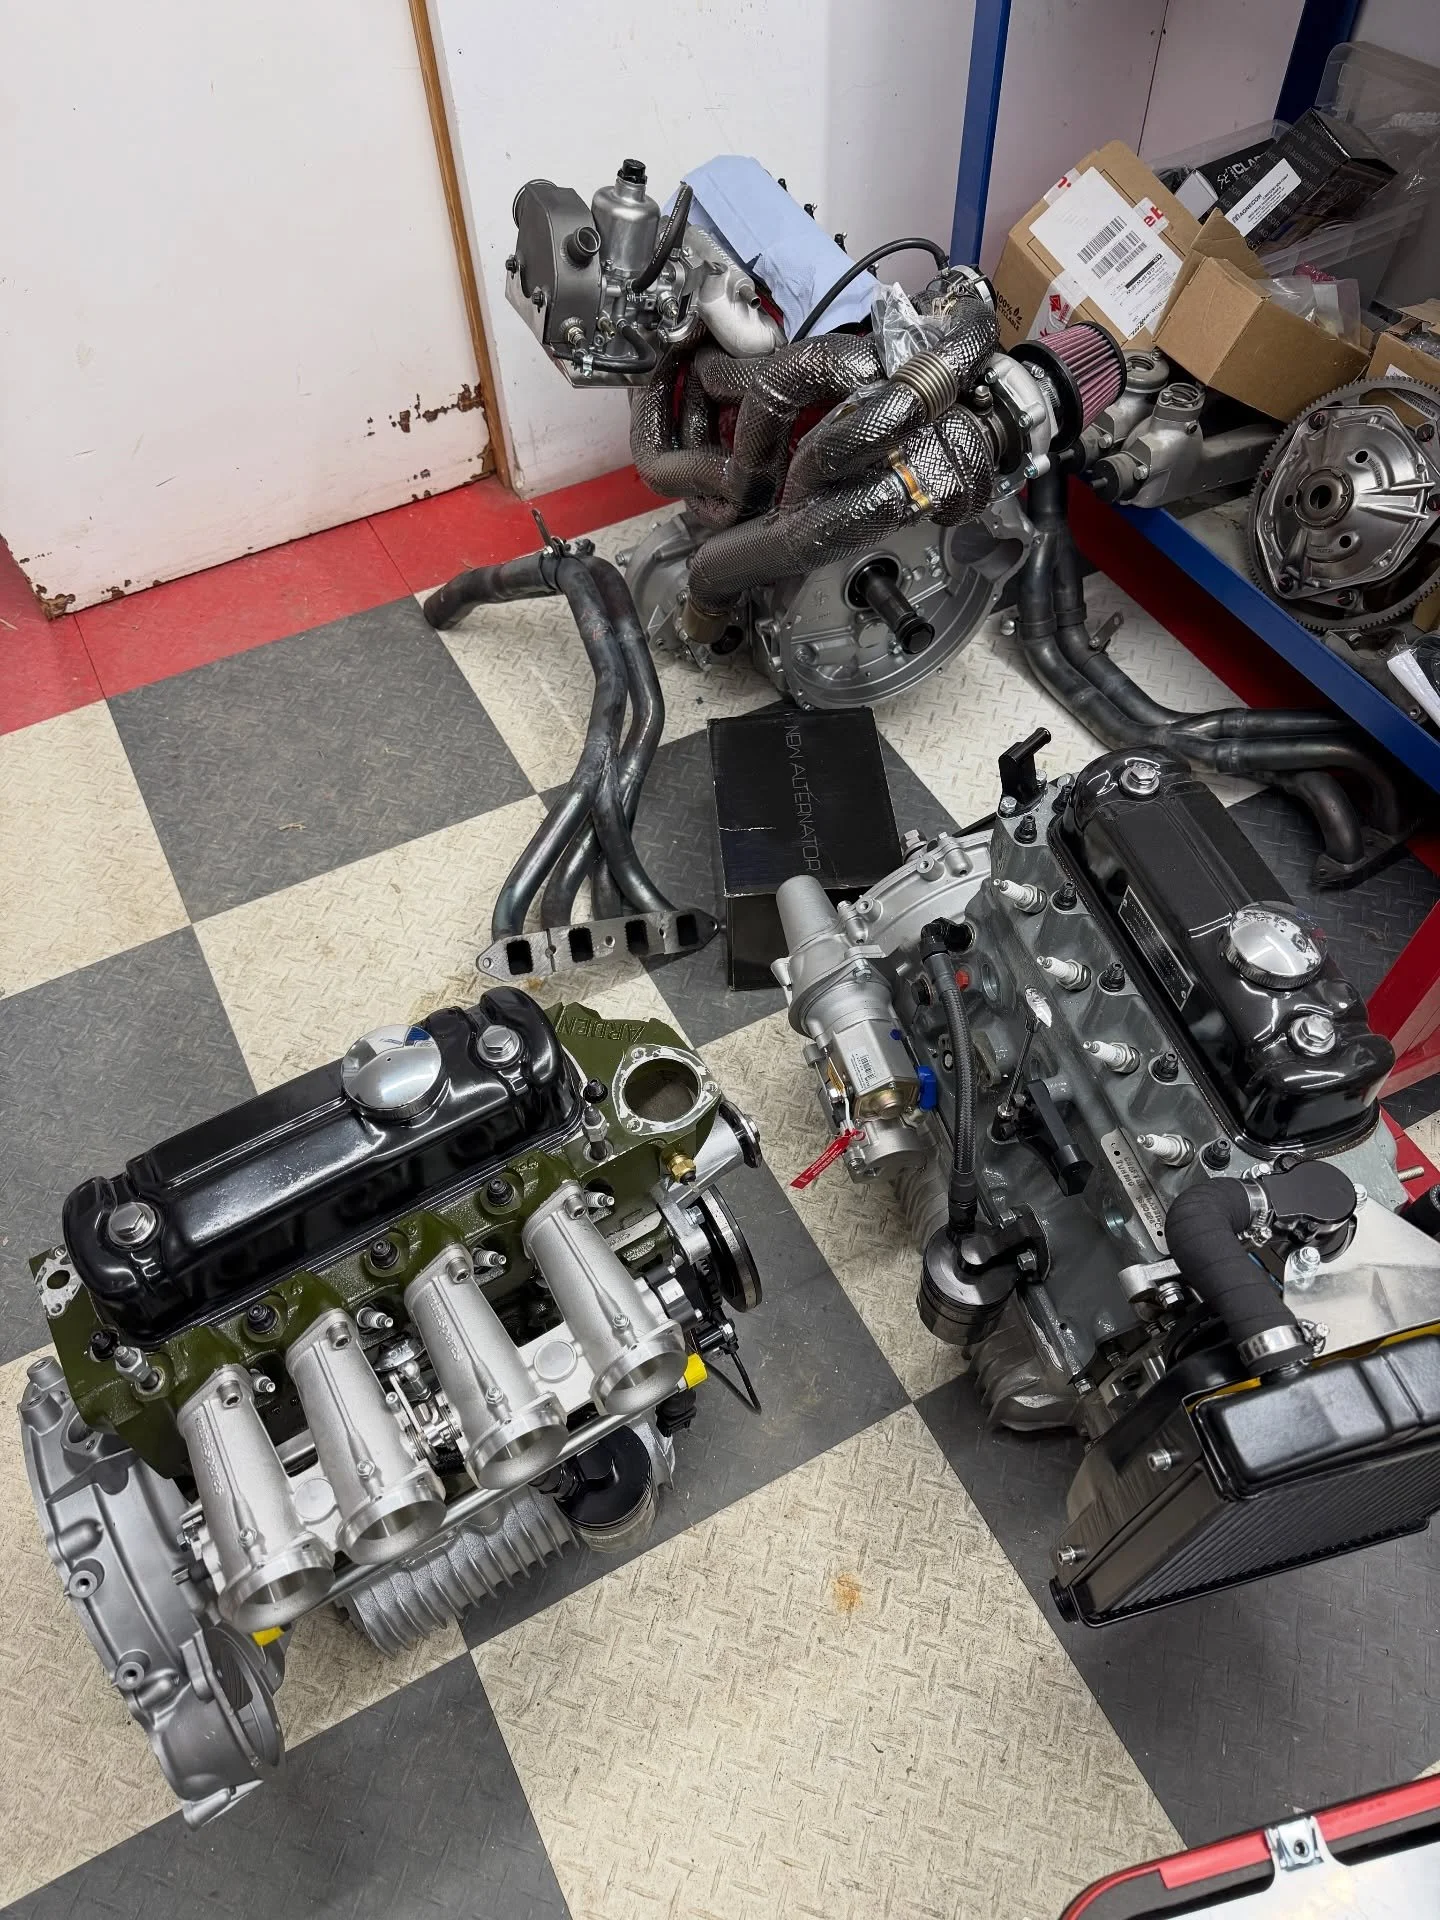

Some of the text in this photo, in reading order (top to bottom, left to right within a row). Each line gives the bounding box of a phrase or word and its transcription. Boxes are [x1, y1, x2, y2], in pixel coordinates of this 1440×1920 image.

[784, 725, 822, 872] NEW ALTERNATOR
[559, 1016, 645, 1043] ARDEN
